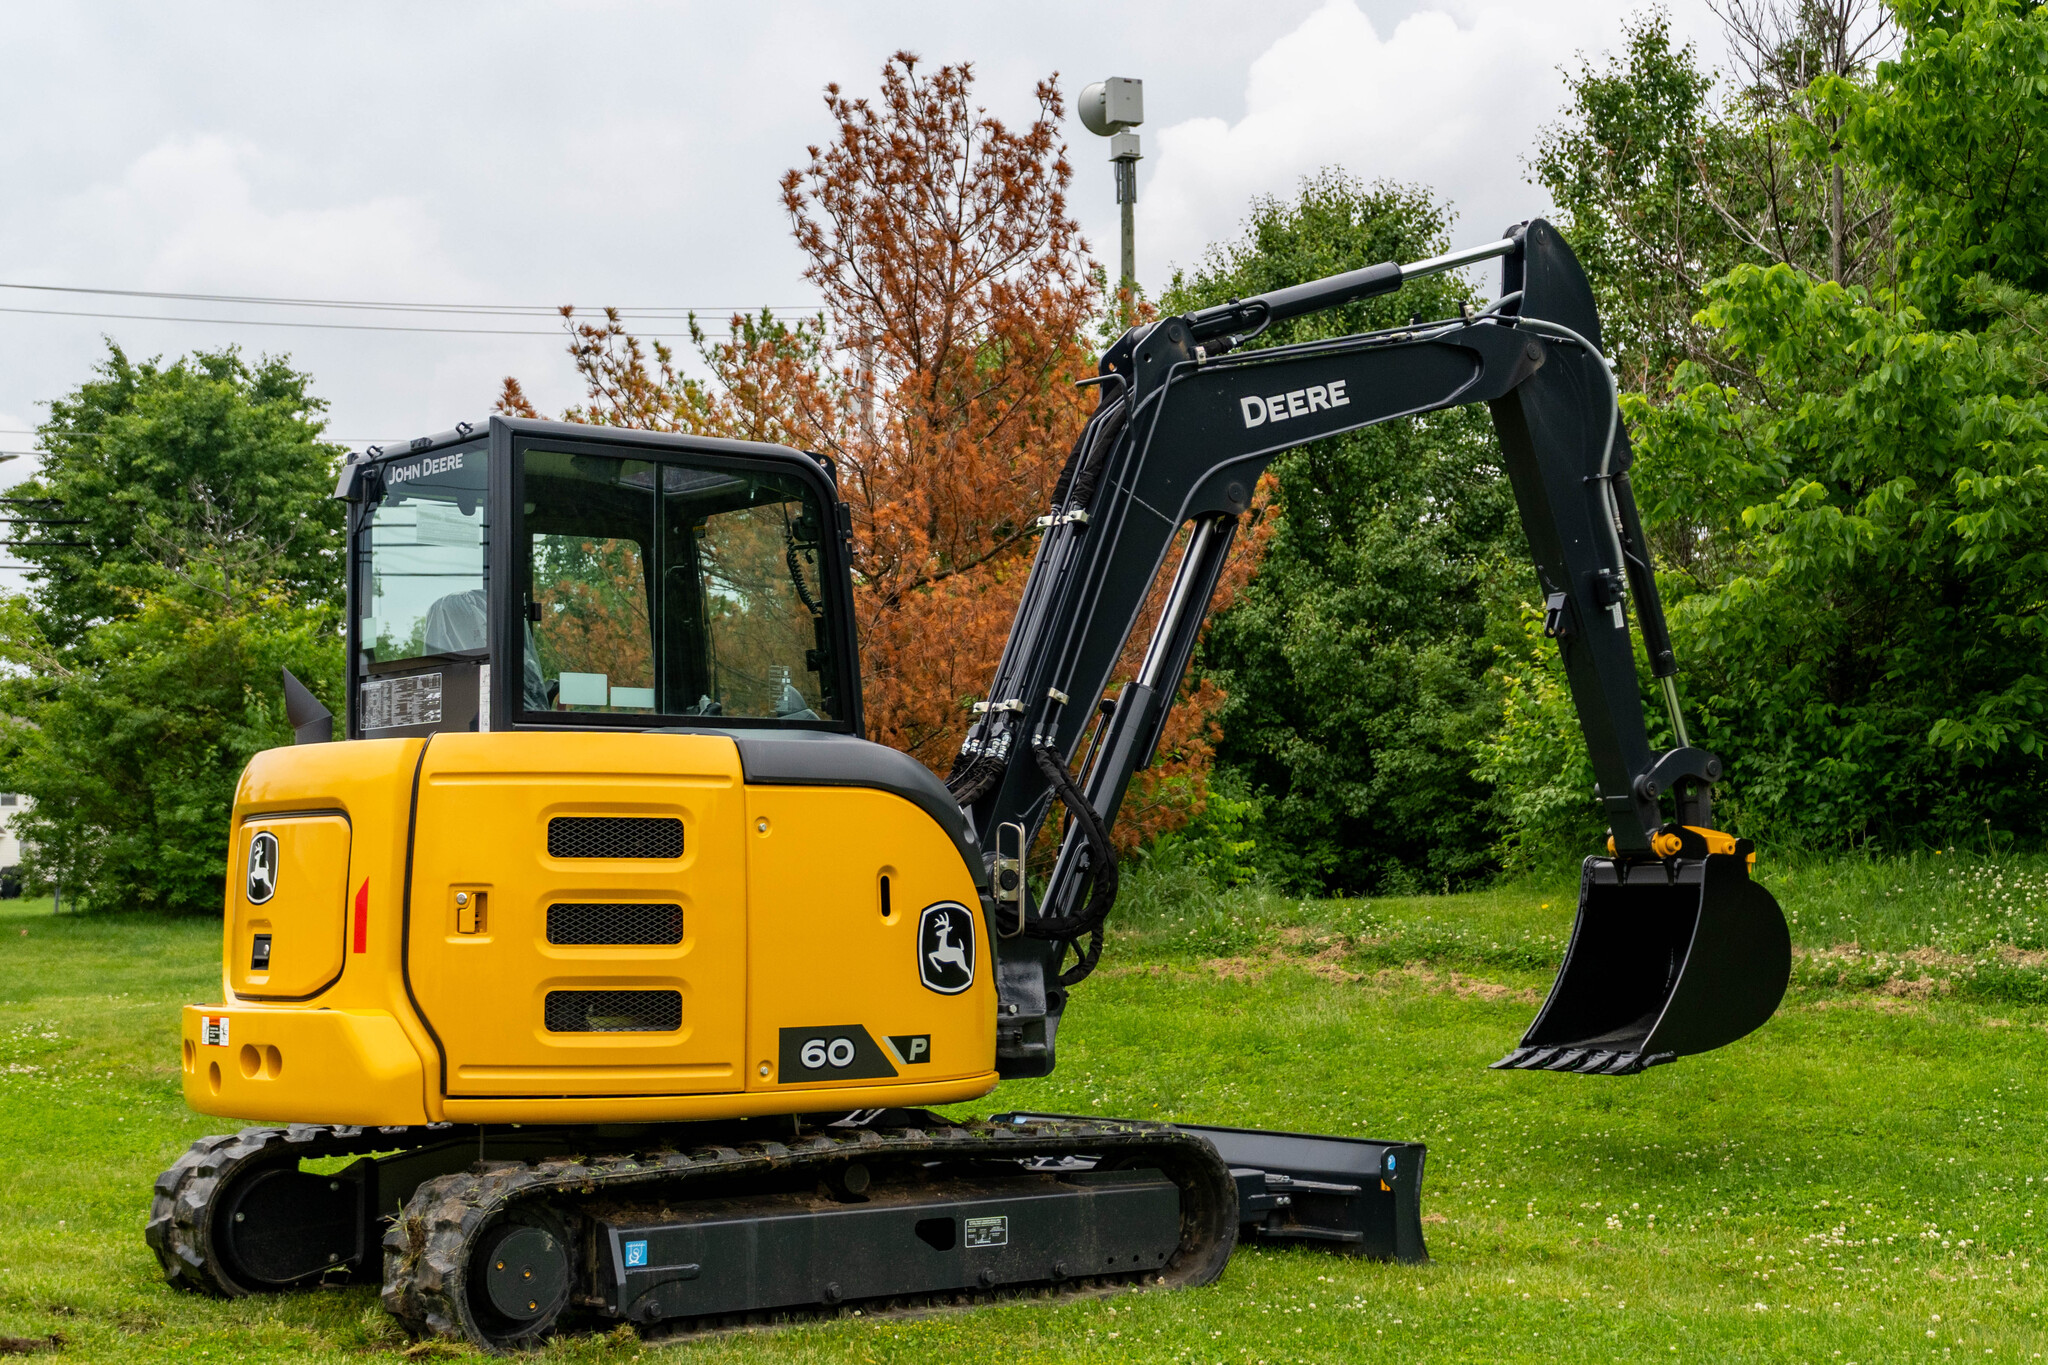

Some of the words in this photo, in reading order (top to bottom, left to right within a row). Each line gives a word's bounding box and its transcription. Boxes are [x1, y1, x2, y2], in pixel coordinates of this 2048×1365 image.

[1240, 380, 1350, 428] DEERE
[388, 463, 421, 485] JOHN
[423, 453, 463, 476] DEERE
[801, 1038, 855, 1068] 60
[909, 1038, 927, 1061] P
